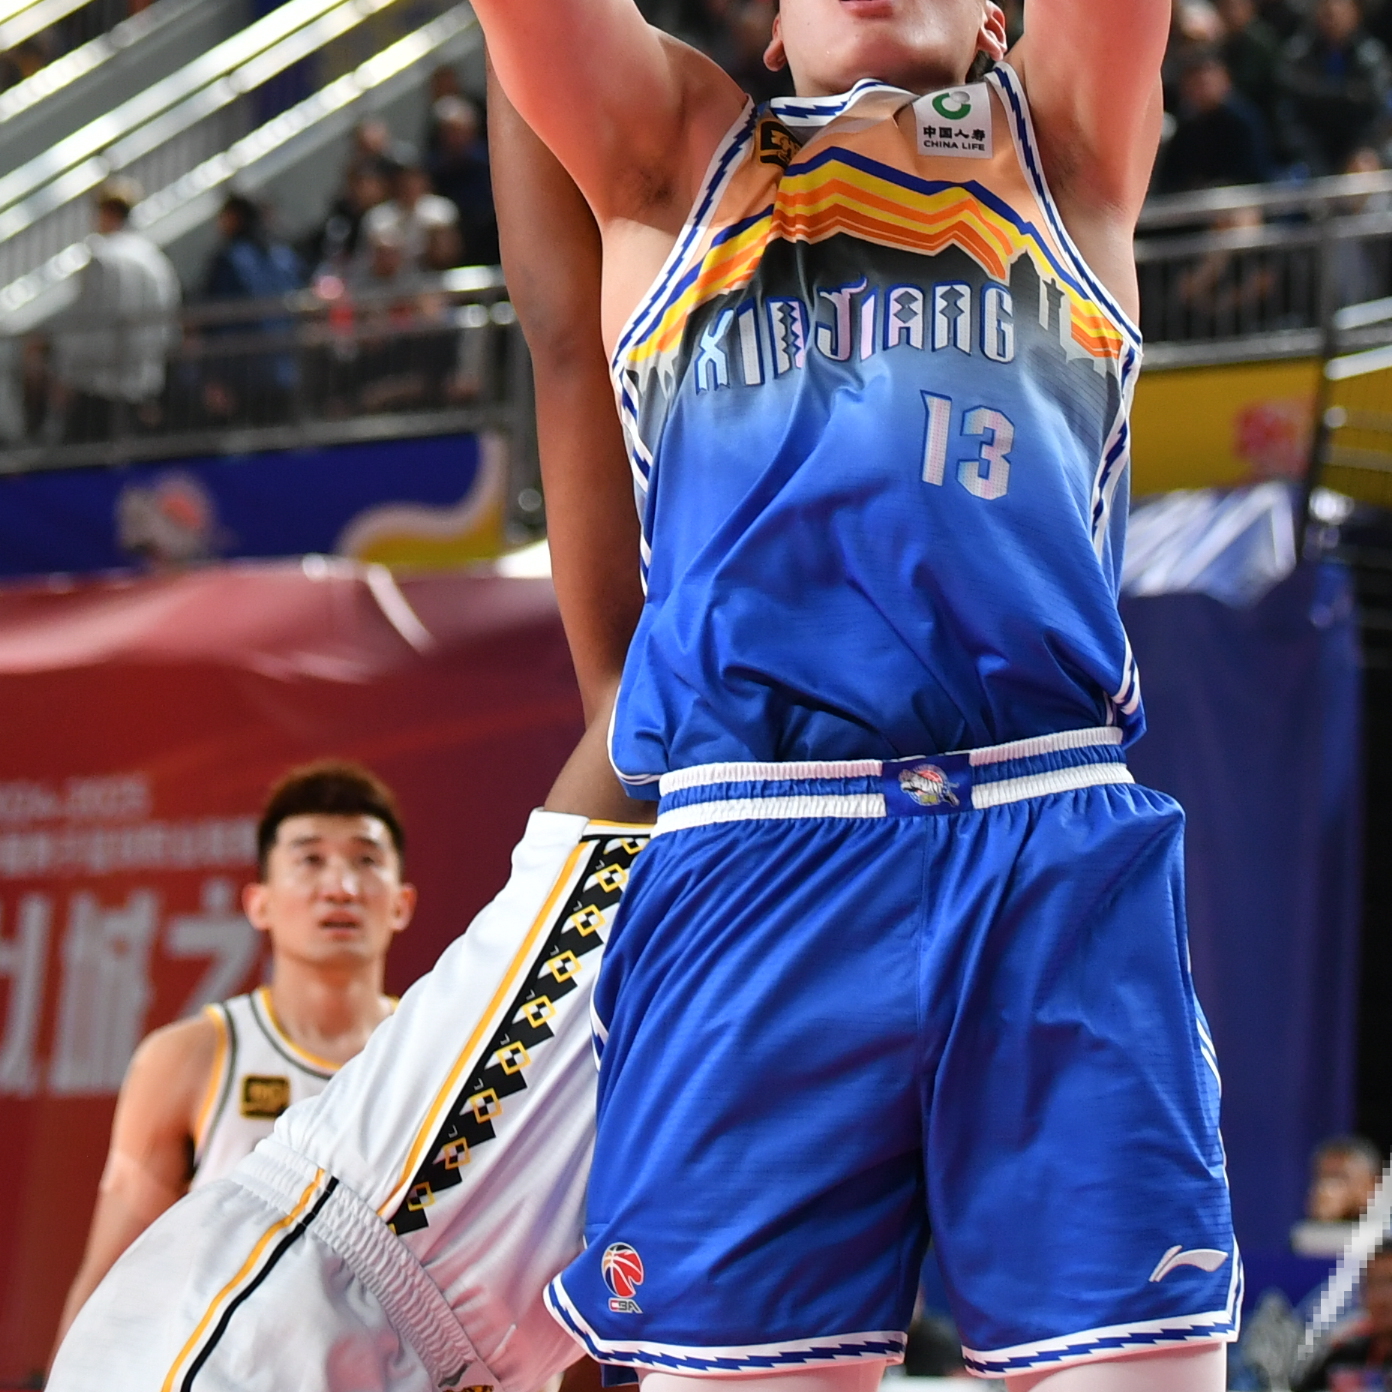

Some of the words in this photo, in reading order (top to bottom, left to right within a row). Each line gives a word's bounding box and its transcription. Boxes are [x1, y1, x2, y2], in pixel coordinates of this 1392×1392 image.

[922, 124, 987, 142] 中国人寿
[922, 139, 959, 150] CHINA
[961, 140, 987, 152] LIFE
[694, 276, 1016, 396] XINJIANG
[920, 389, 1016, 501] 13
[608, 1297, 644, 1314] CBA
